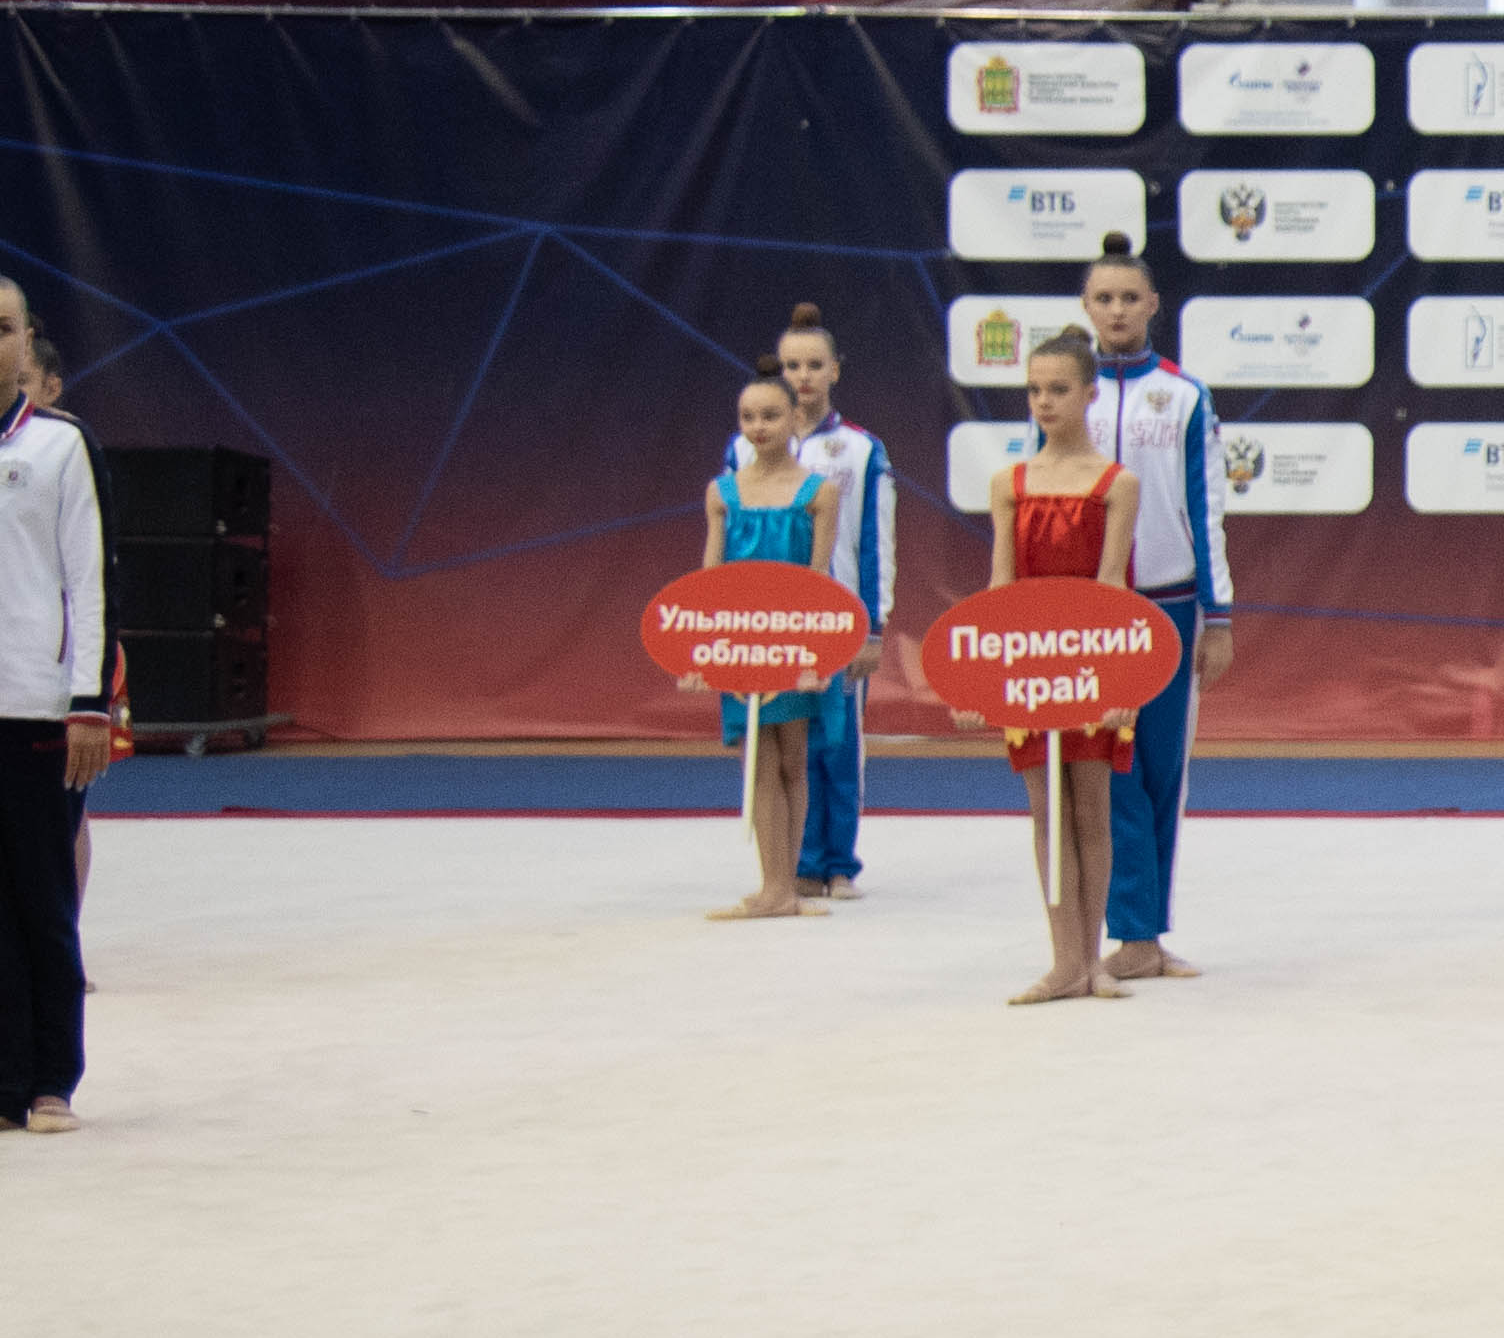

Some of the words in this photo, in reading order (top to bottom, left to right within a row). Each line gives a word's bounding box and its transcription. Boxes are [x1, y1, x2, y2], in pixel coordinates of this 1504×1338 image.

[1029, 190, 1076, 214] ВТБ
[658, 603, 855, 633] Ульяновская
[691, 637, 818, 667] область
[949, 617, 1153, 665] Пермский
[1004, 666, 1100, 713] край
